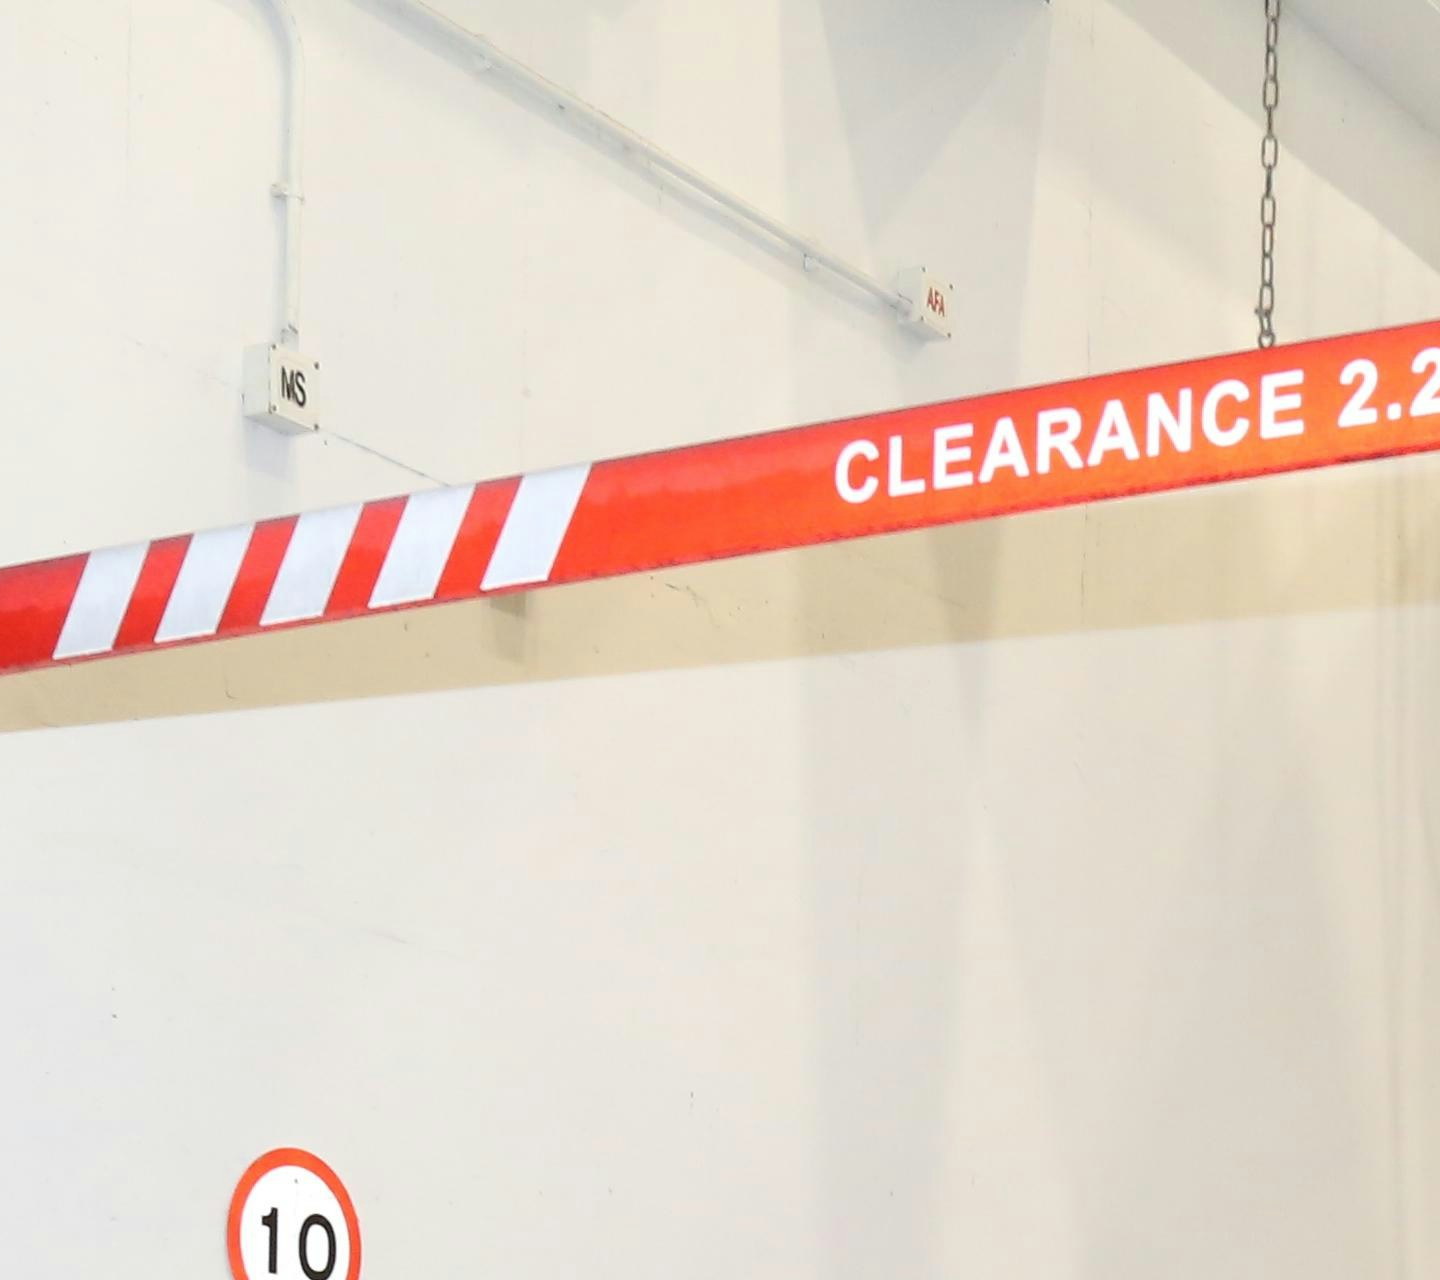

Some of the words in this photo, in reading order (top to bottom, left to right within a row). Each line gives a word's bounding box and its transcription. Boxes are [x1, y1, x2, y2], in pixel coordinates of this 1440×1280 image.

[926, 286, 945, 317] AFA
[281, 365, 307, 408] MS
[834, 369, 1305, 504] CLEARANCE
